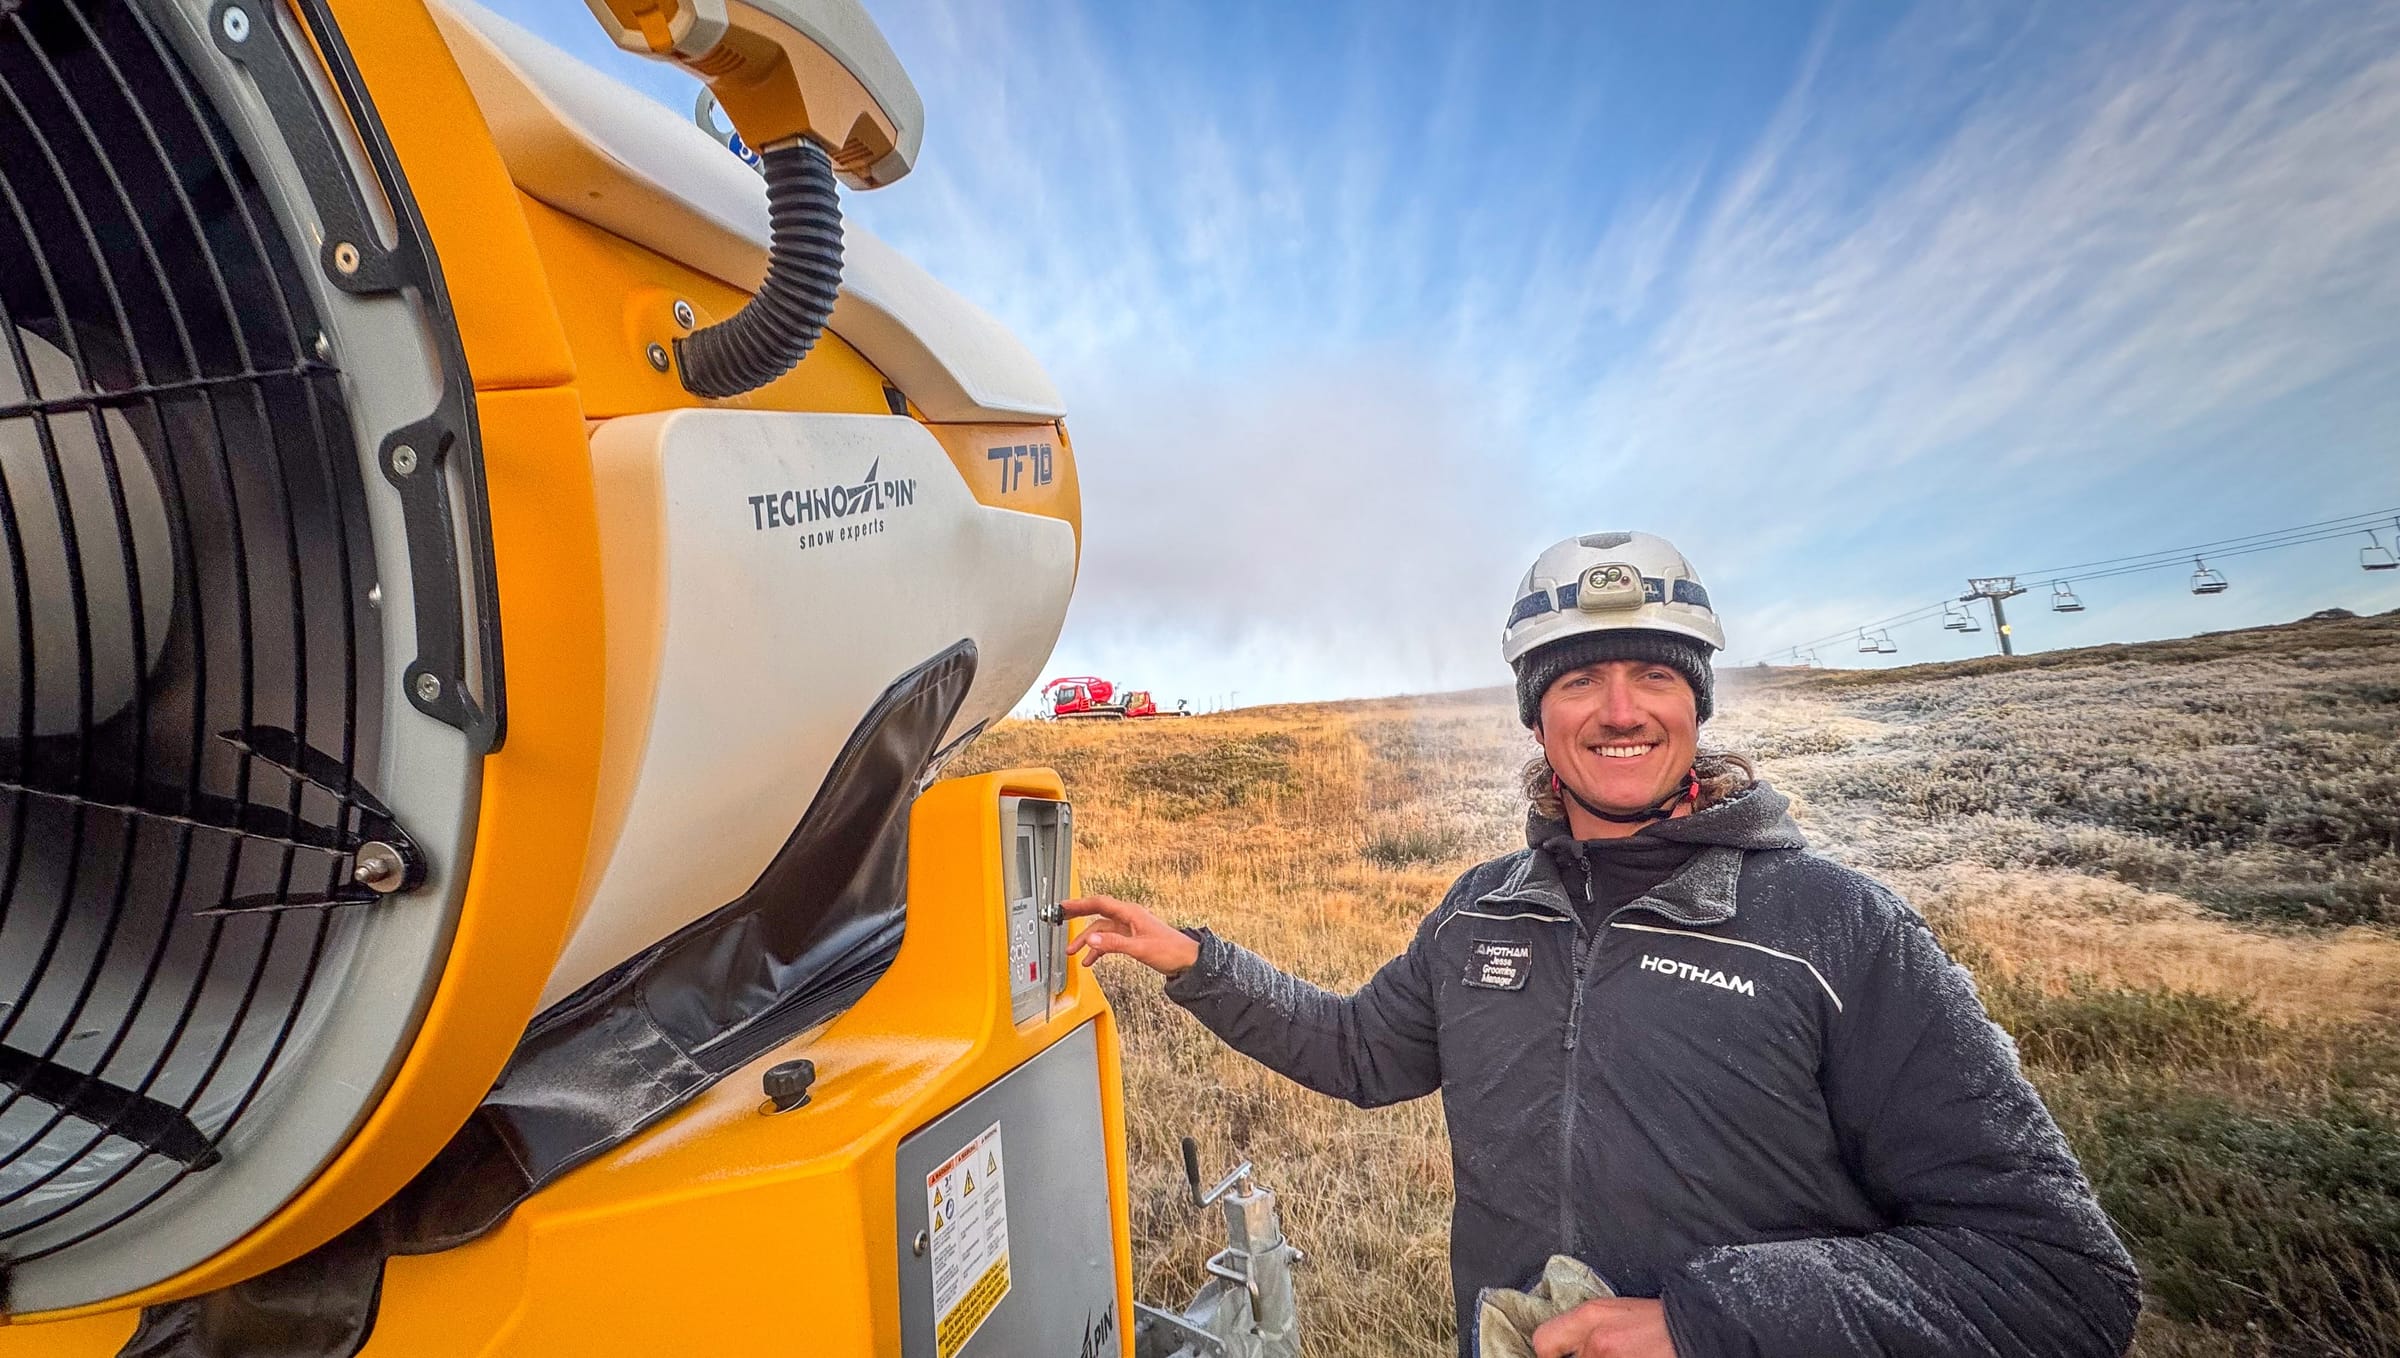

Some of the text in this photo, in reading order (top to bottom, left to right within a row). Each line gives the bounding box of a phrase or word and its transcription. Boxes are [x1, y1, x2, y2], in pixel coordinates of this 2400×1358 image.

[988, 444, 1052, 493] TF10
[800, 518, 884, 549] snow experts
[1486, 946, 1529, 957] HOTHAM
[1490, 957, 1512, 966] Jesse
[1482, 964, 1516, 978] Grooming
[1640, 955, 1755, 997] HOTHAM
[1481, 974, 1512, 987] Manager
